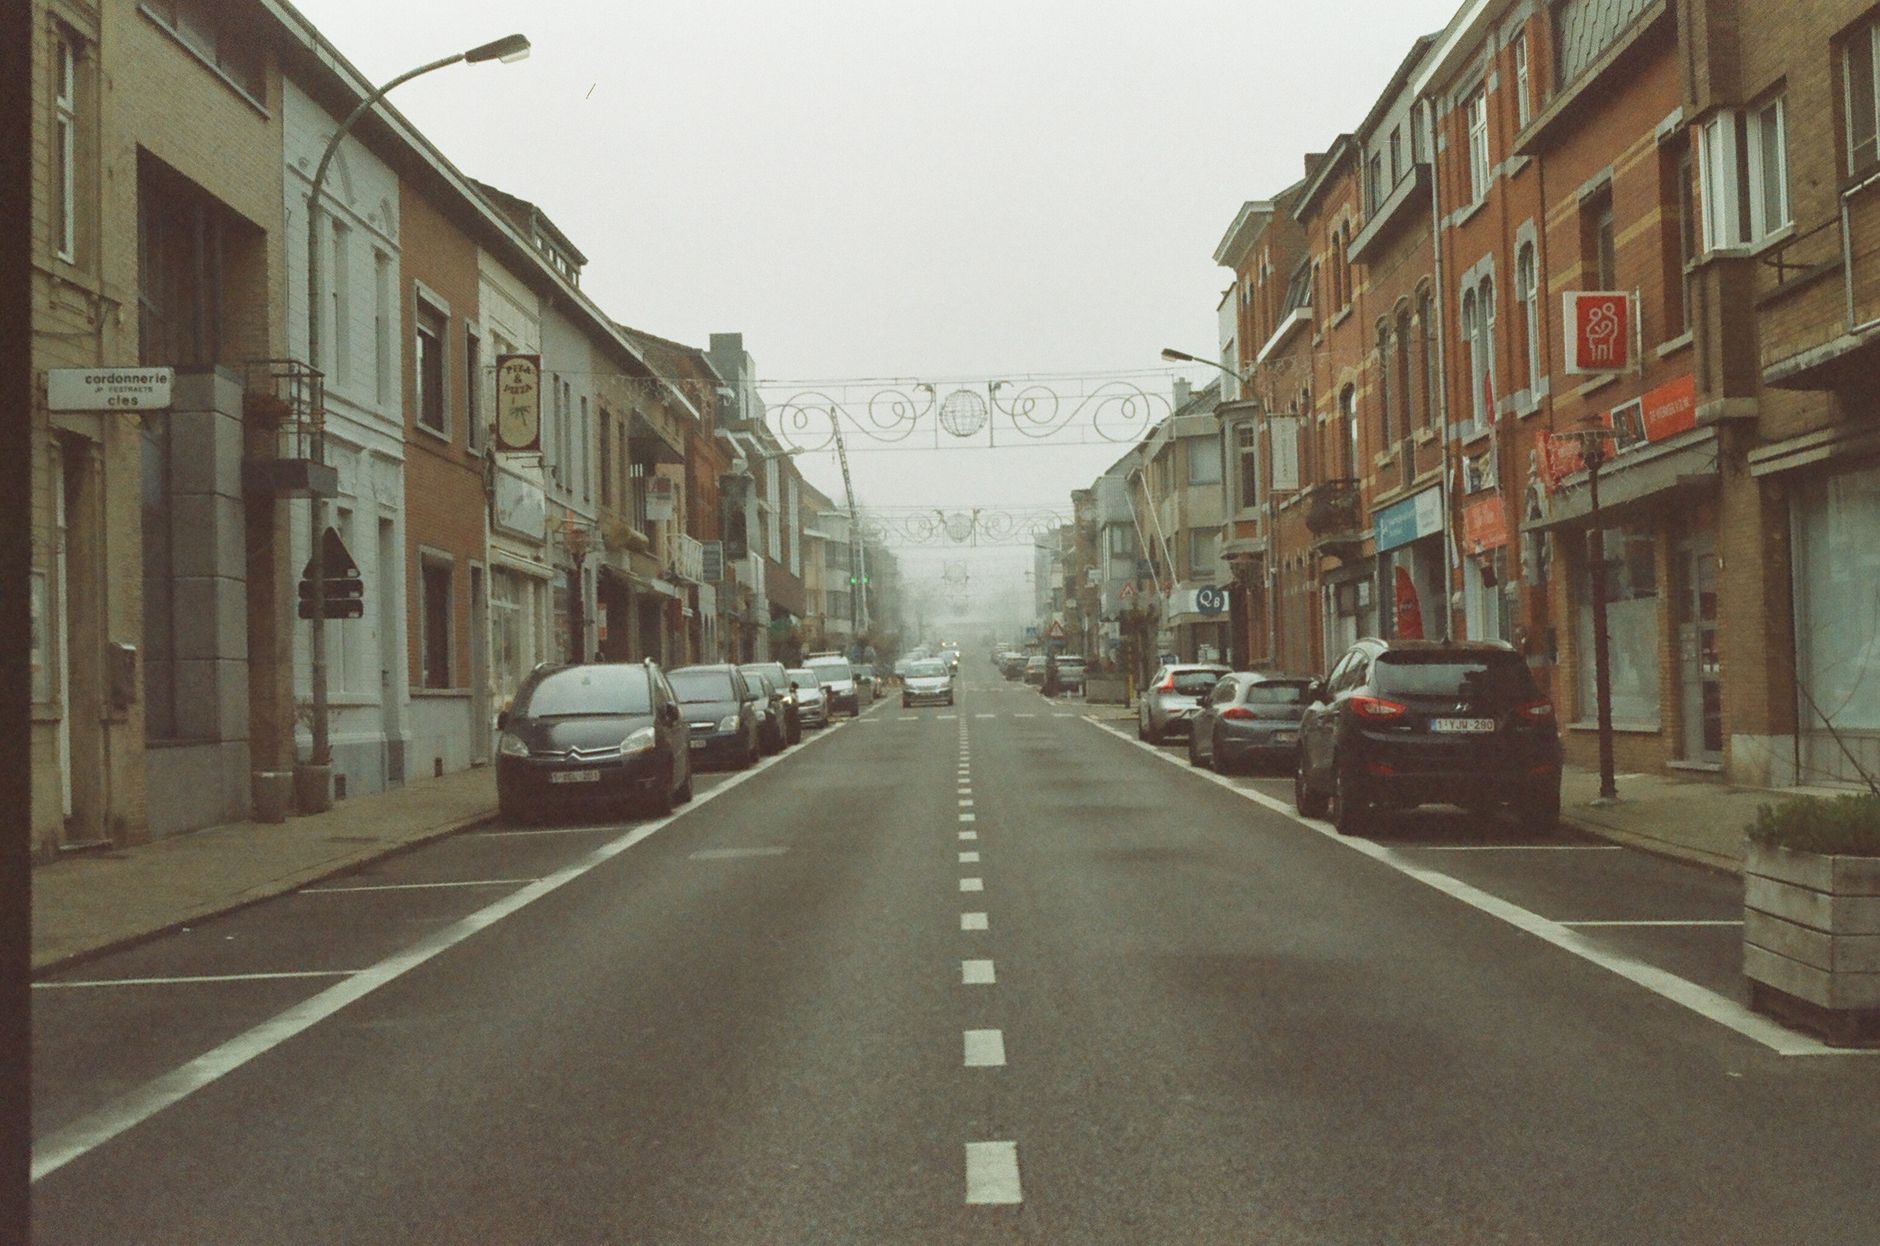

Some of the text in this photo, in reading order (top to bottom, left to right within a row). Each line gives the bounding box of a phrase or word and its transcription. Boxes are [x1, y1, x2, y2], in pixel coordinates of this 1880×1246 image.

[506, 364, 531, 375] PITA
[85, 373, 168, 384] cordonnerie
[514, 373, 522, 384] &
[503, 383, 533, 395] PIZZA
[107, 395, 138, 406] cles
